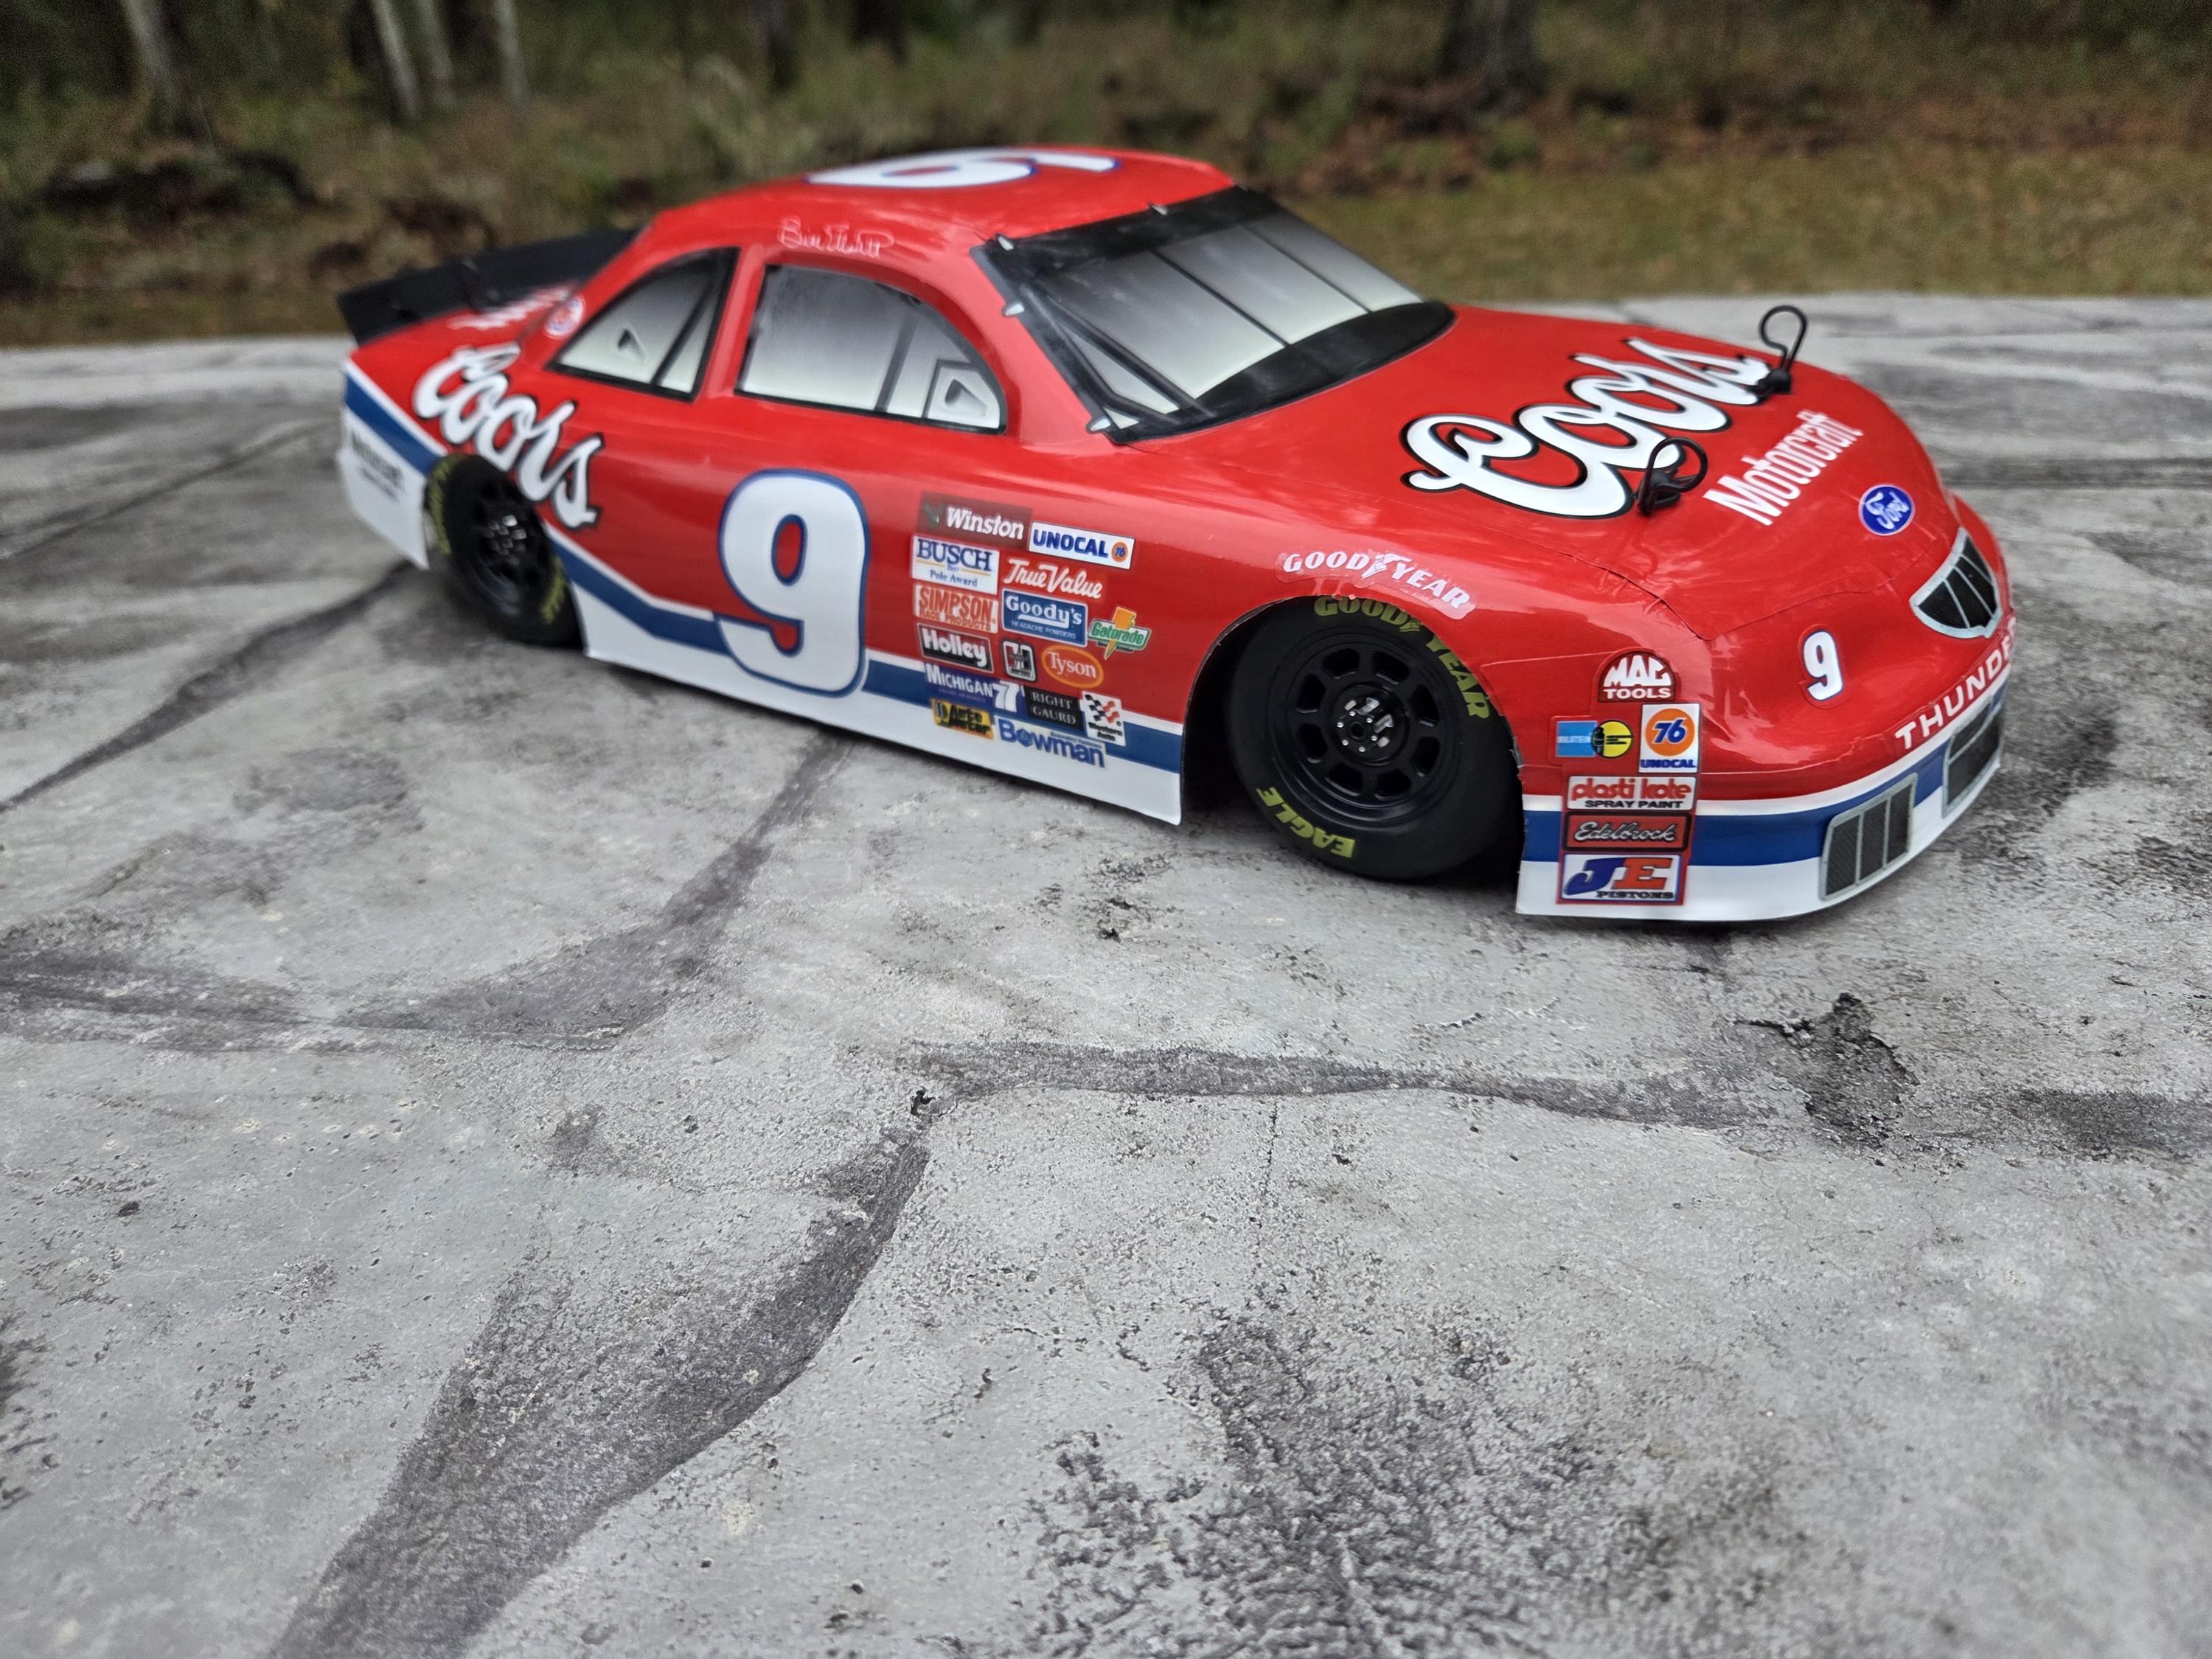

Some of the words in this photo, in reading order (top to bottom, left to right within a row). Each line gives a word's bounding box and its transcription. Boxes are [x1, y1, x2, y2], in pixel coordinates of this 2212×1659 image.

[413, 341, 603, 528] Coors
[1401, 337, 1771, 519] Coors
[1703, 409, 1864, 526] Motorcraft
[947, 507, 1024, 540] Winston
[1865, 490, 1910, 529] Ford
[917, 538, 992, 571] BUSCH
[1033, 529, 1108, 558] UNOCAL
[717, 467, 871, 698] 9
[930, 569, 947, 581] Pole
[950, 574, 978, 587] Award
[919, 587, 993, 622] SIMPSON
[1006, 595, 1082, 626] Goody's
[922, 627, 987, 667] Holley
[1091, 622, 1144, 645] Gatorade
[1047, 650, 1097, 678] Tyson
[1603, 655, 1672, 686] MAC
[1803, 630, 1844, 700] 9
[926, 663, 993, 698] MICHIGAN
[1603, 687, 1672, 699] TOOLS
[1032, 692, 1074, 709] RIGHT
[1032, 706, 1077, 725] GAURD
[998, 719, 1105, 768] Bowman
[1652, 717, 1687, 744] 76
[1640, 759, 1696, 768] UNOCAL
[1571, 778, 1635, 801] plasti
[1641, 778, 1691, 799] kote
[1585, 800, 1635, 808] SPRAY
[1256, 786, 1357, 859] EAGLE
[1574, 821, 1676, 842] Edelbrock
[1564, 857, 1673, 895] JE
[1596, 891, 1674, 899] PISTONS
